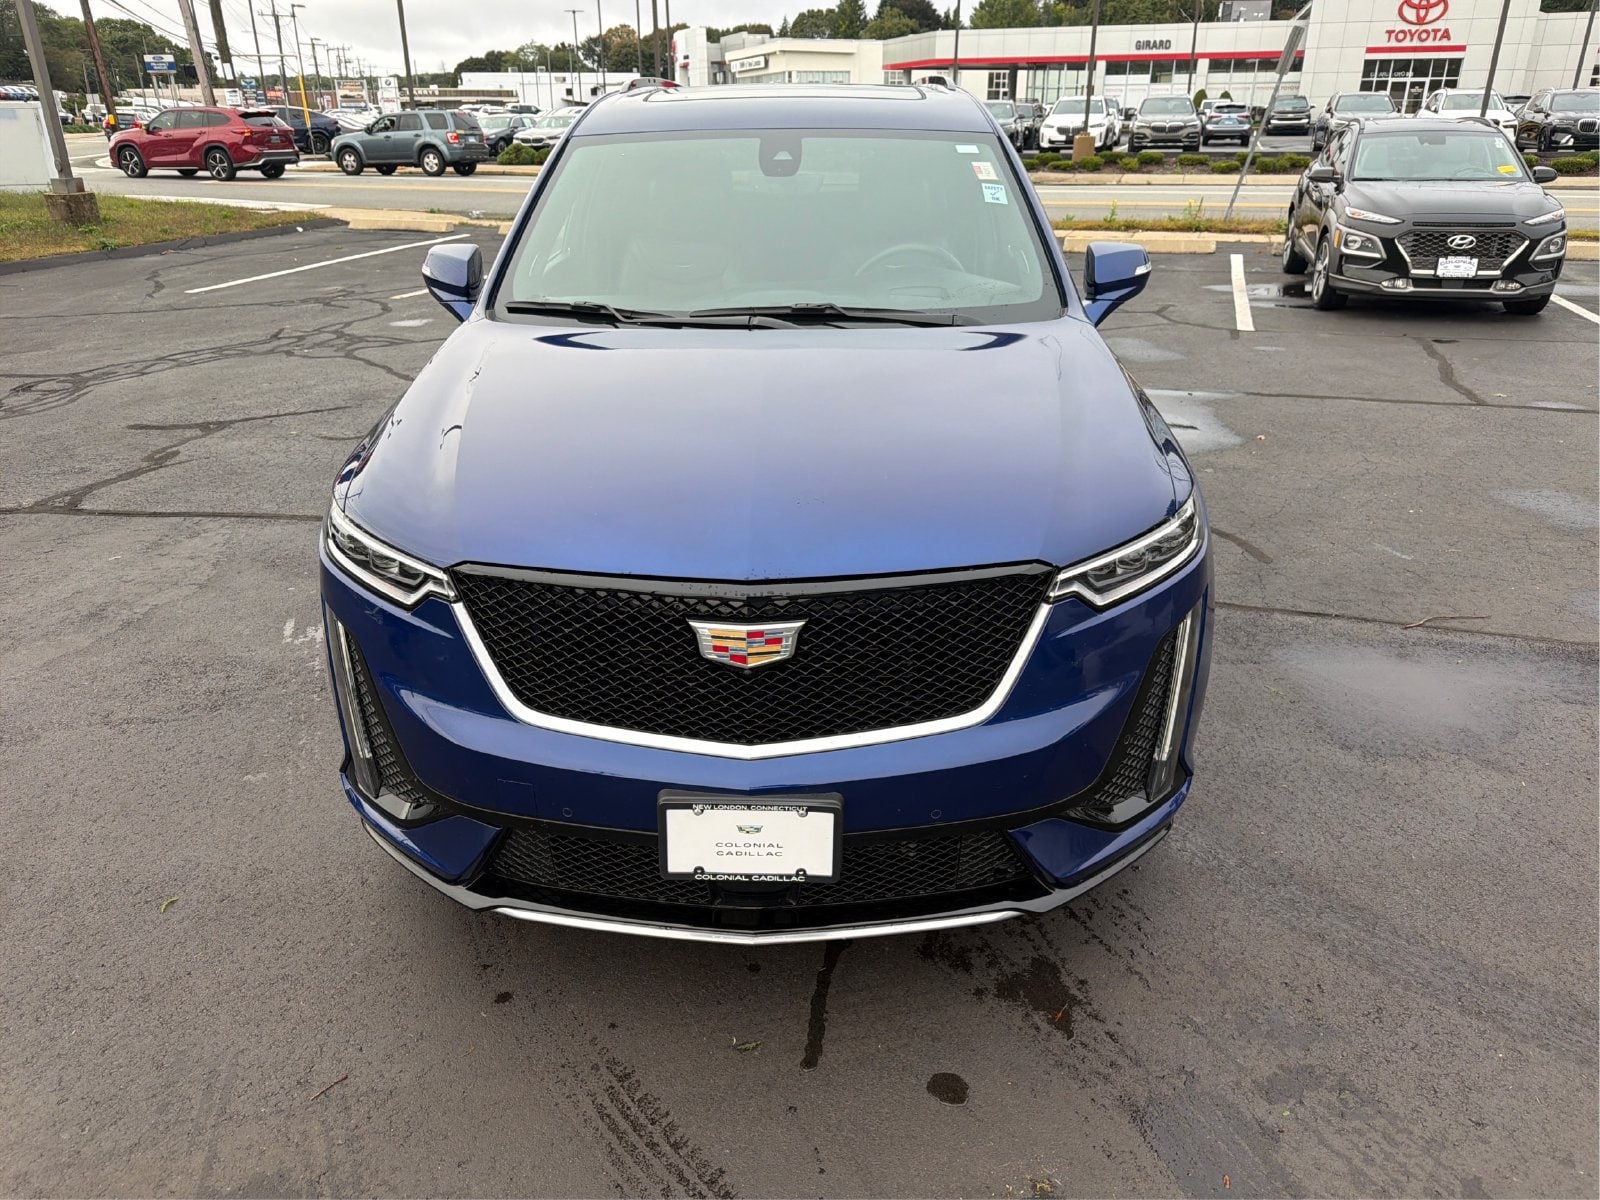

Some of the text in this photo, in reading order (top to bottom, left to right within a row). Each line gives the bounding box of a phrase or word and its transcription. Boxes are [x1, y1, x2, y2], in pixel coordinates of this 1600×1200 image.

[1385, 28, 1452, 43] TOYOTA
[1135, 39, 1172, 51] GIRARD
[750, 805, 808, 813] CONNECTICUT
